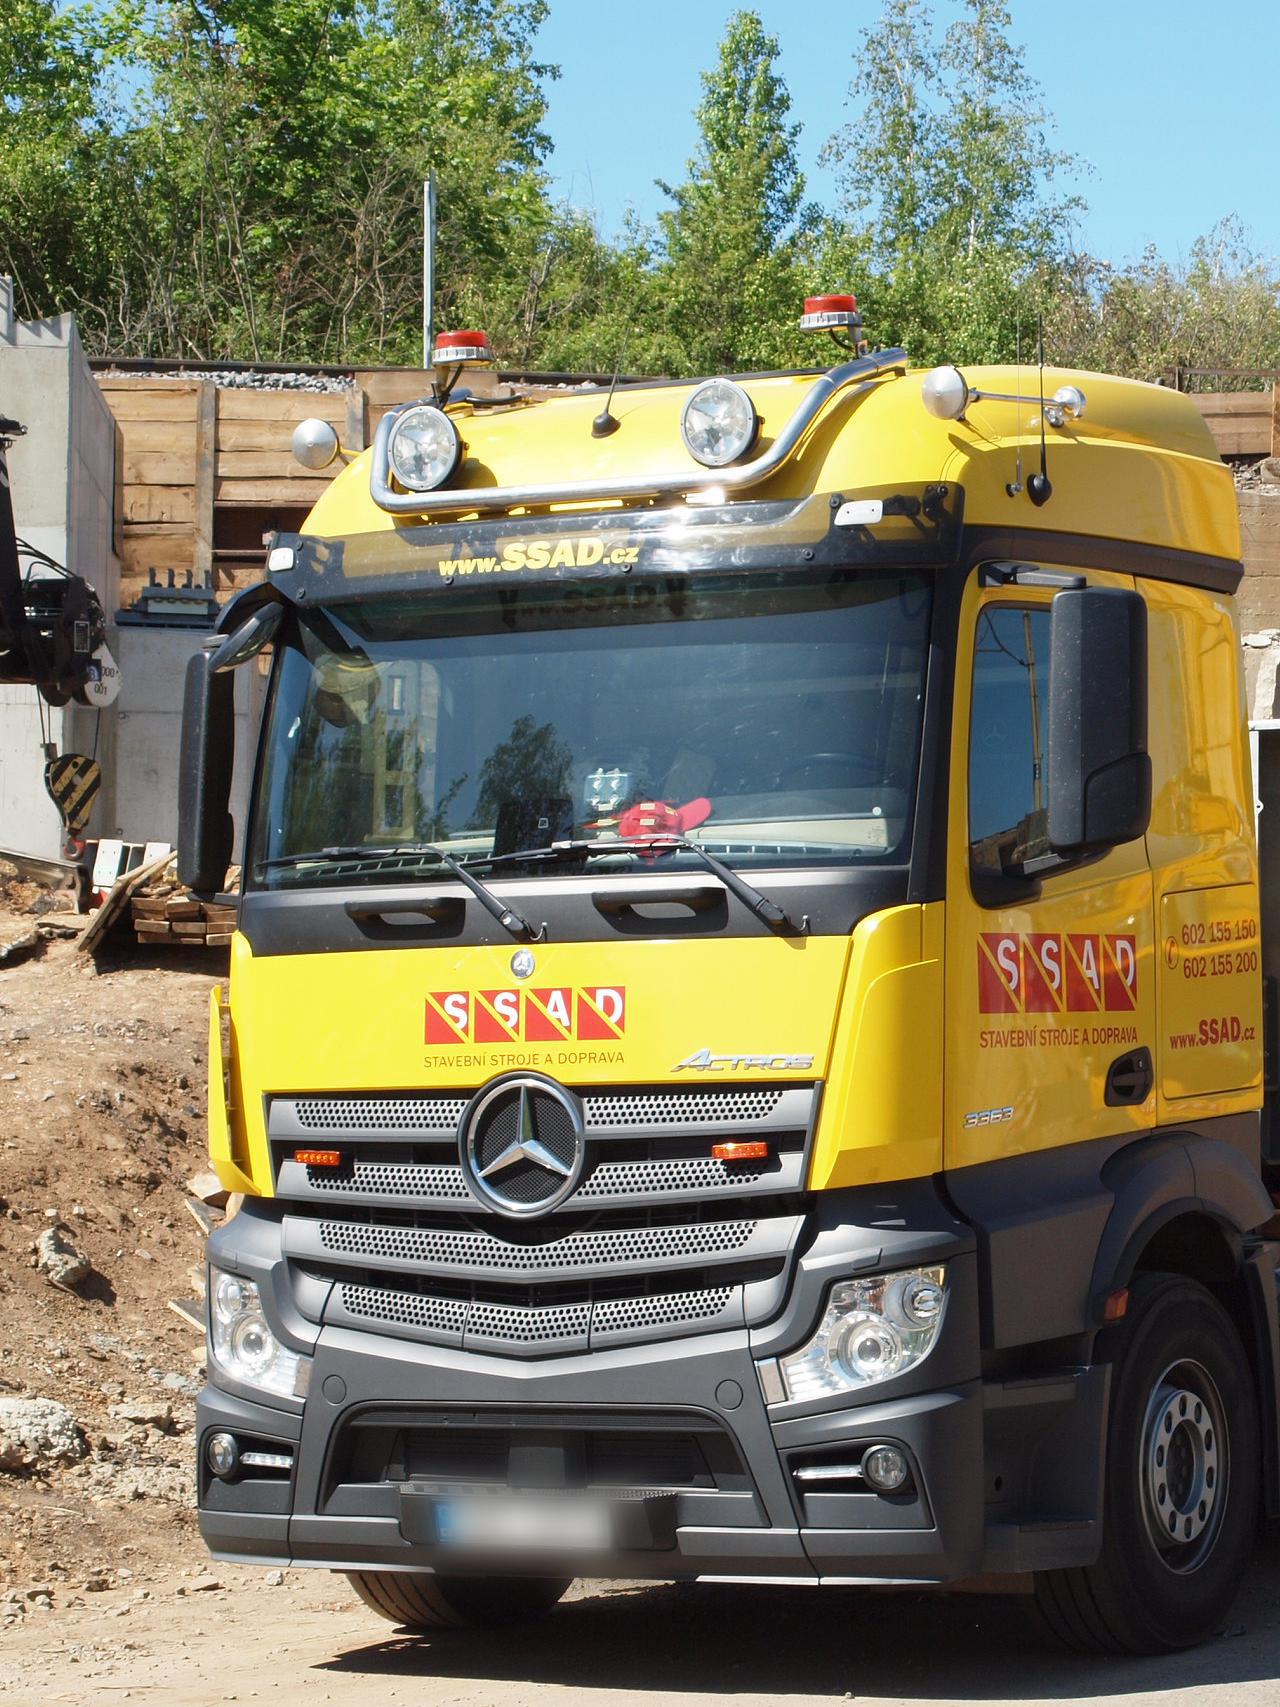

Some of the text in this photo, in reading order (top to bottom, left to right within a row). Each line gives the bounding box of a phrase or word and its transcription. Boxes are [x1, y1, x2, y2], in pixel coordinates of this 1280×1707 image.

[438, 537, 640, 576] www.SSAD.cz
[1182, 919, 1256, 945] 602 155 150
[995, 937, 1136, 993] SSAD
[1184, 951, 1257, 978] 602 155 200
[442, 986, 624, 1031] SSAD
[979, 1025, 1138, 1049] STAVEBNÍ STROJE A DOPRAVA
[1169, 1015, 1255, 1049] www.SSAD.cz
[423, 1051, 625, 1068] STAVEBNÍ STROJE A DOPRAVA
